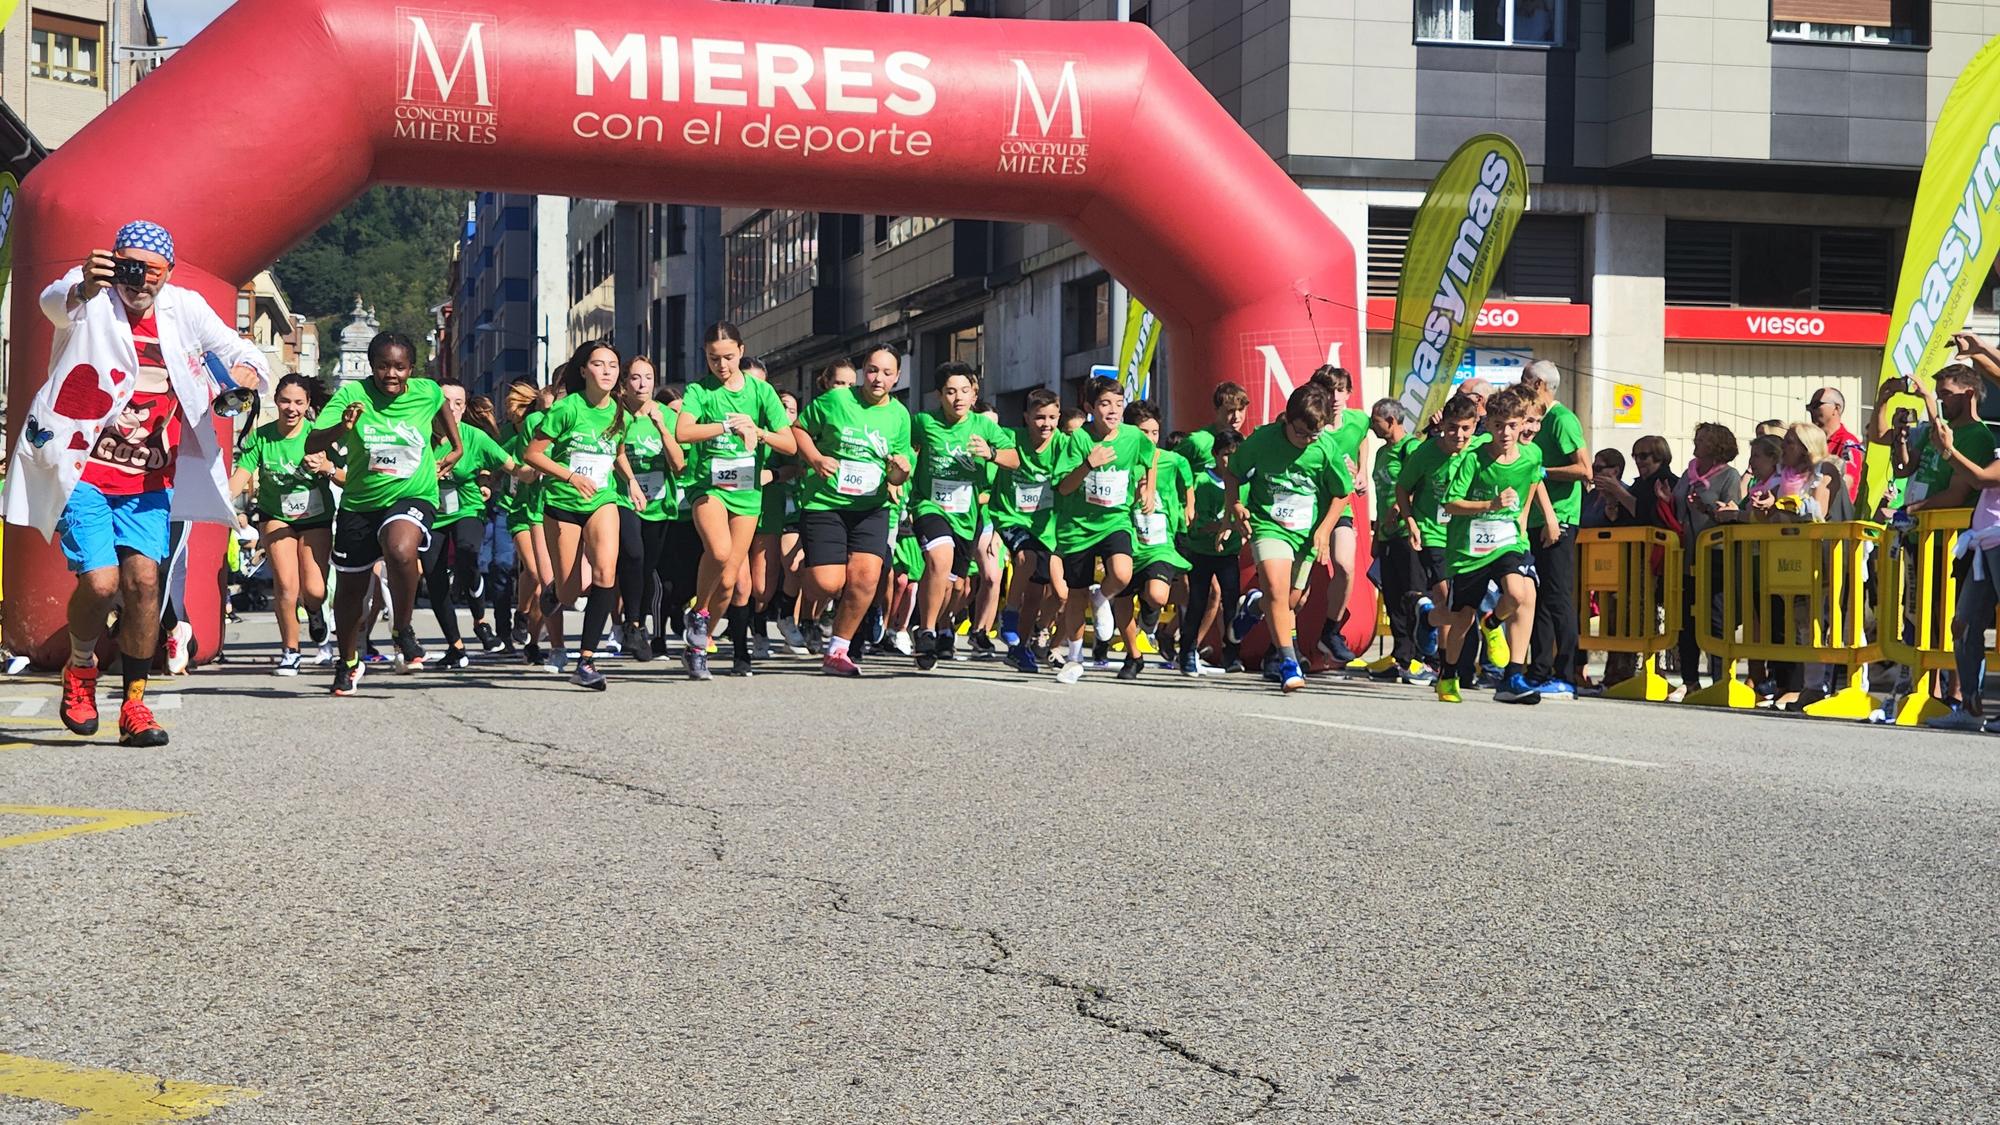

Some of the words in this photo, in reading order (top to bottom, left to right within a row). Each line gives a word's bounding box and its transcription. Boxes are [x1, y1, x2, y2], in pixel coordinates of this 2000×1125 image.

[401, 15, 493, 107] M
[574, 29, 937, 116] MIERES
[1007, 58, 1086, 139] M
[395, 105, 471, 123] CONCEYU
[476, 111, 498, 125] DE
[393, 119, 497, 145] MIERES
[572, 111, 663, 142] con
[682, 111, 721, 145] el
[741, 113, 932, 157] deporte
[1000, 141, 1067, 156] CONCEYU
[1069, 143, 1090, 157] DE
[997, 154, 1087, 175] MIERES
[1473, 179, 1517, 286] SUPERMERCADOS
[1400, 150, 1510, 431] masymas
[376, 456, 397, 465] 704
[575, 465, 593, 476] 401
[718, 470, 738, 480] 325
[843, 474, 863, 485] 406
[935, 492, 953, 502] 323
[1090, 485, 1111, 496] 319
[1021, 494, 1039, 503] 380
[287, 502, 306, 512] 345
[1275, 507, 1295, 518] 352
[1475, 533, 1496, 544] 232
